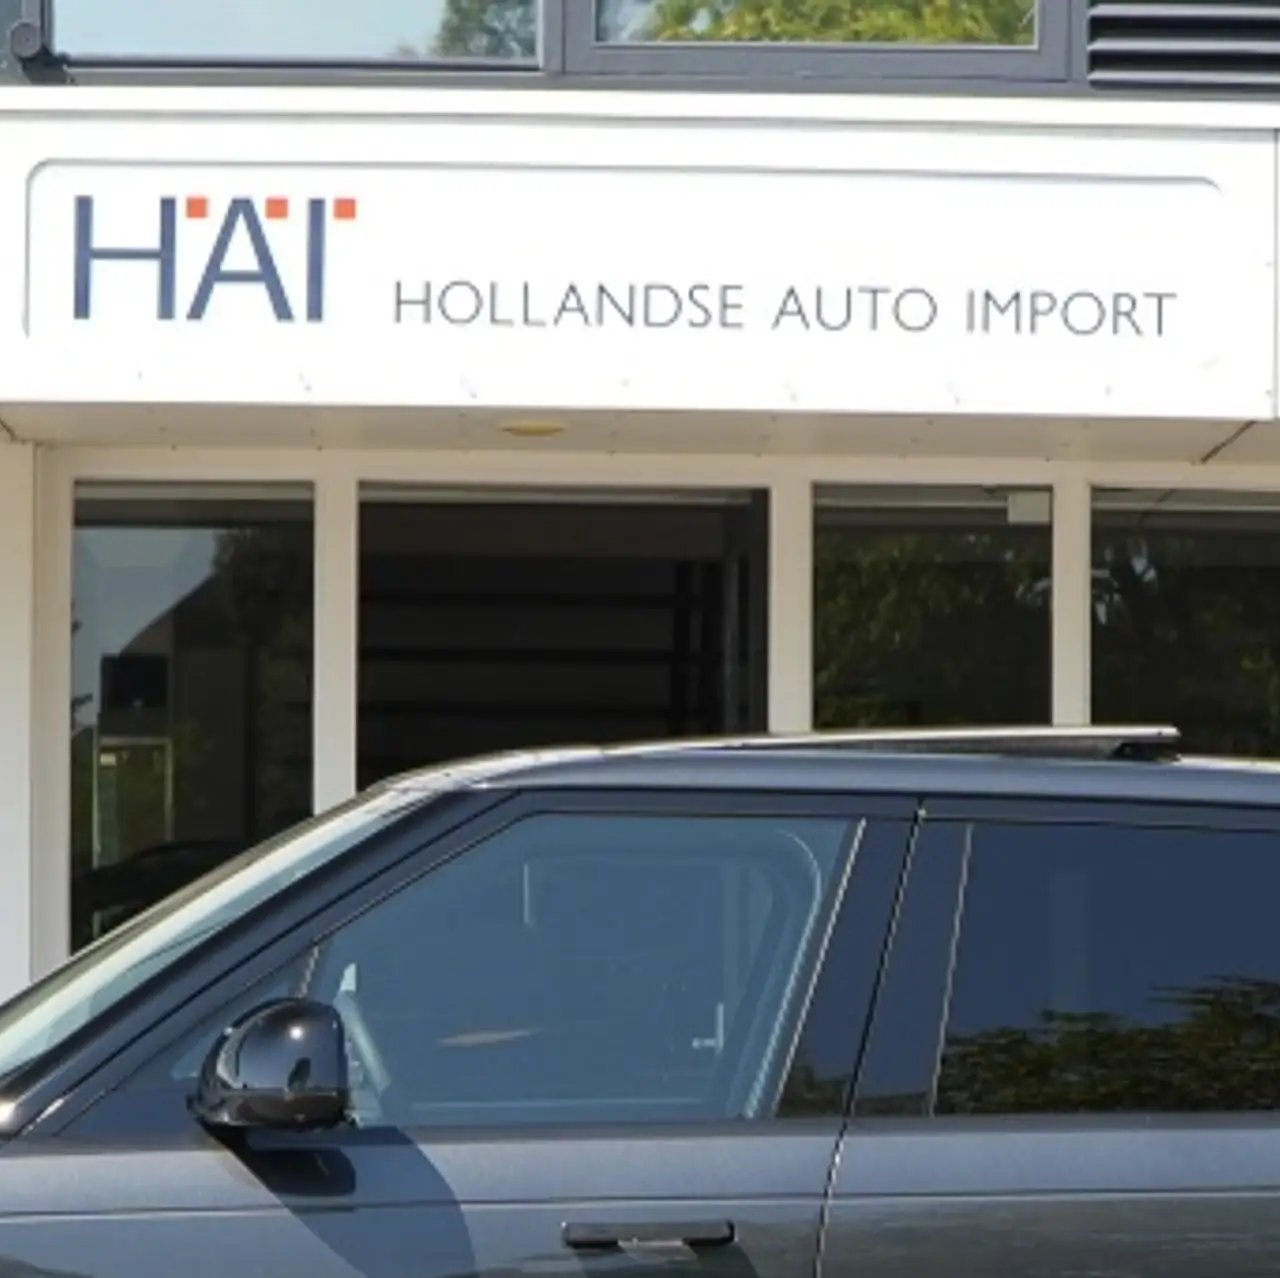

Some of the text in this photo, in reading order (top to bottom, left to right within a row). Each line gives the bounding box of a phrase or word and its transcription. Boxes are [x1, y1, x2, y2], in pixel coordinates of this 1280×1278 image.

[394, 279, 1177, 337] HOLLANDSE AUTO IMPORT
